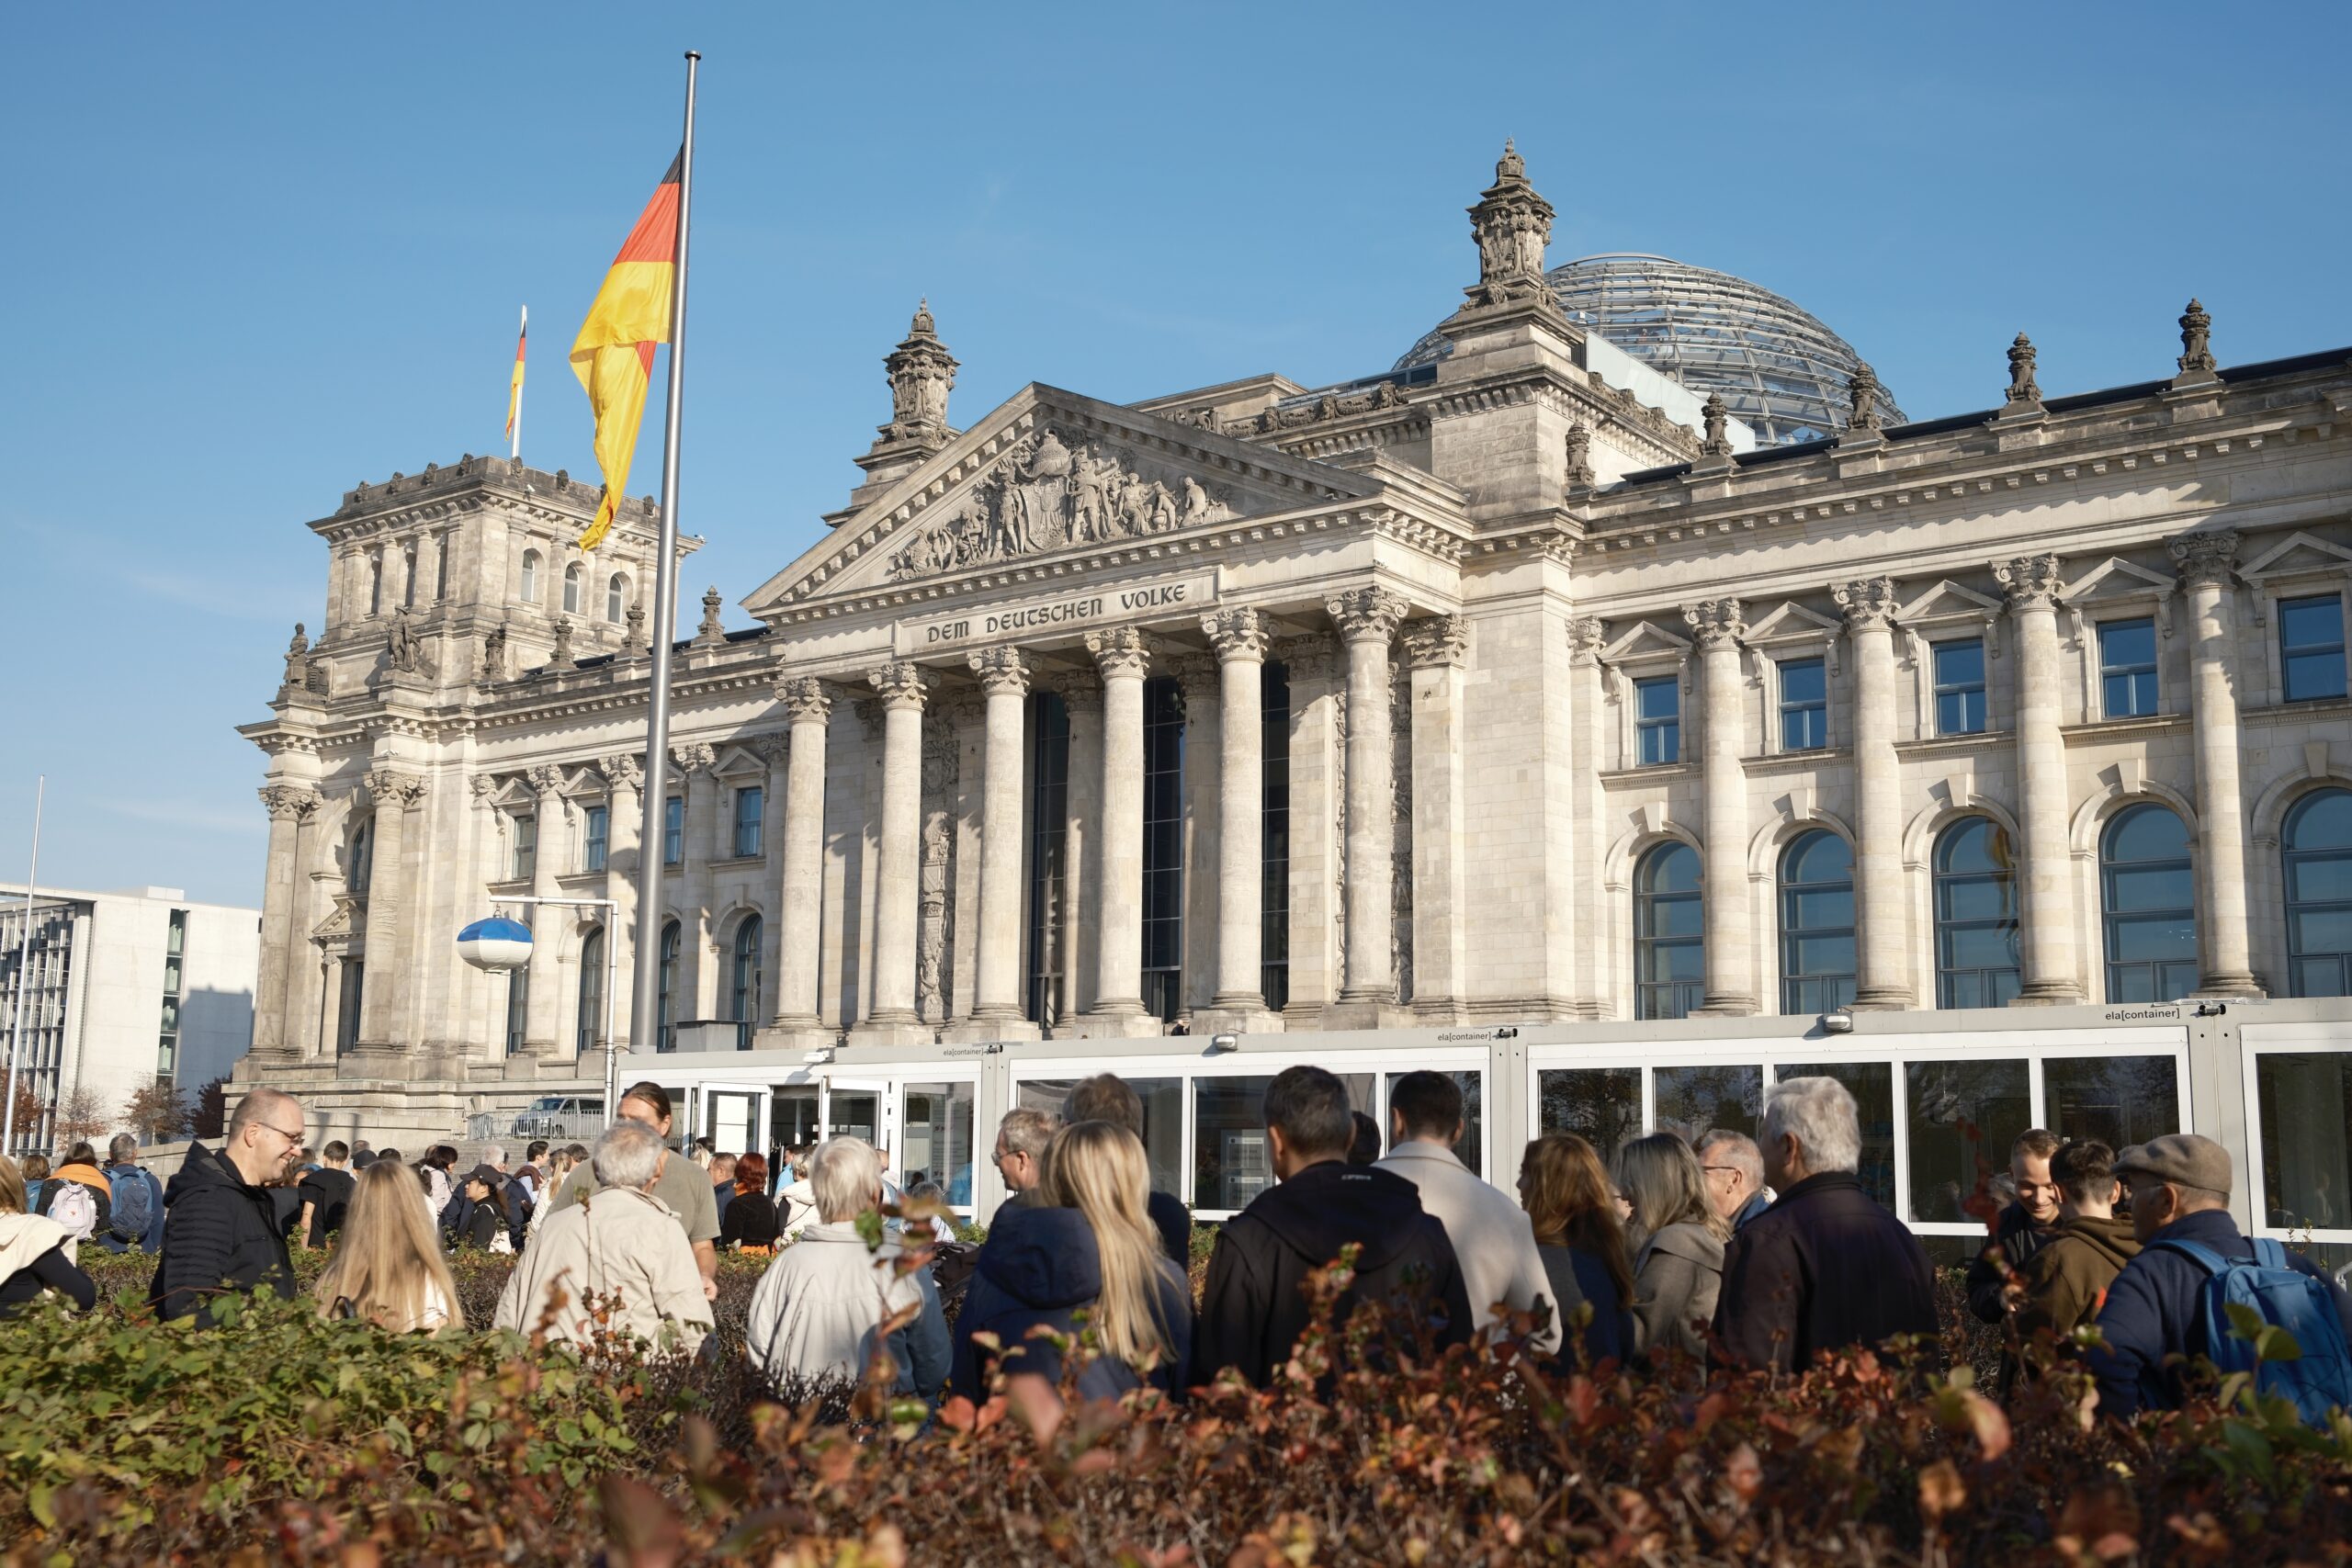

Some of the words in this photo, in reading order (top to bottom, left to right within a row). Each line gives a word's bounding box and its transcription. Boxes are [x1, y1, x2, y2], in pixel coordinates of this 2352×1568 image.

[926, 620, 969, 643] DEM
[985, 598, 1102, 634] DEUTSCHEN
[1121, 584, 1186, 610] VOLKE
[2105, 1008, 2180, 1021] ela[container]
[1438, 1031, 1491, 1042] ela[container]
